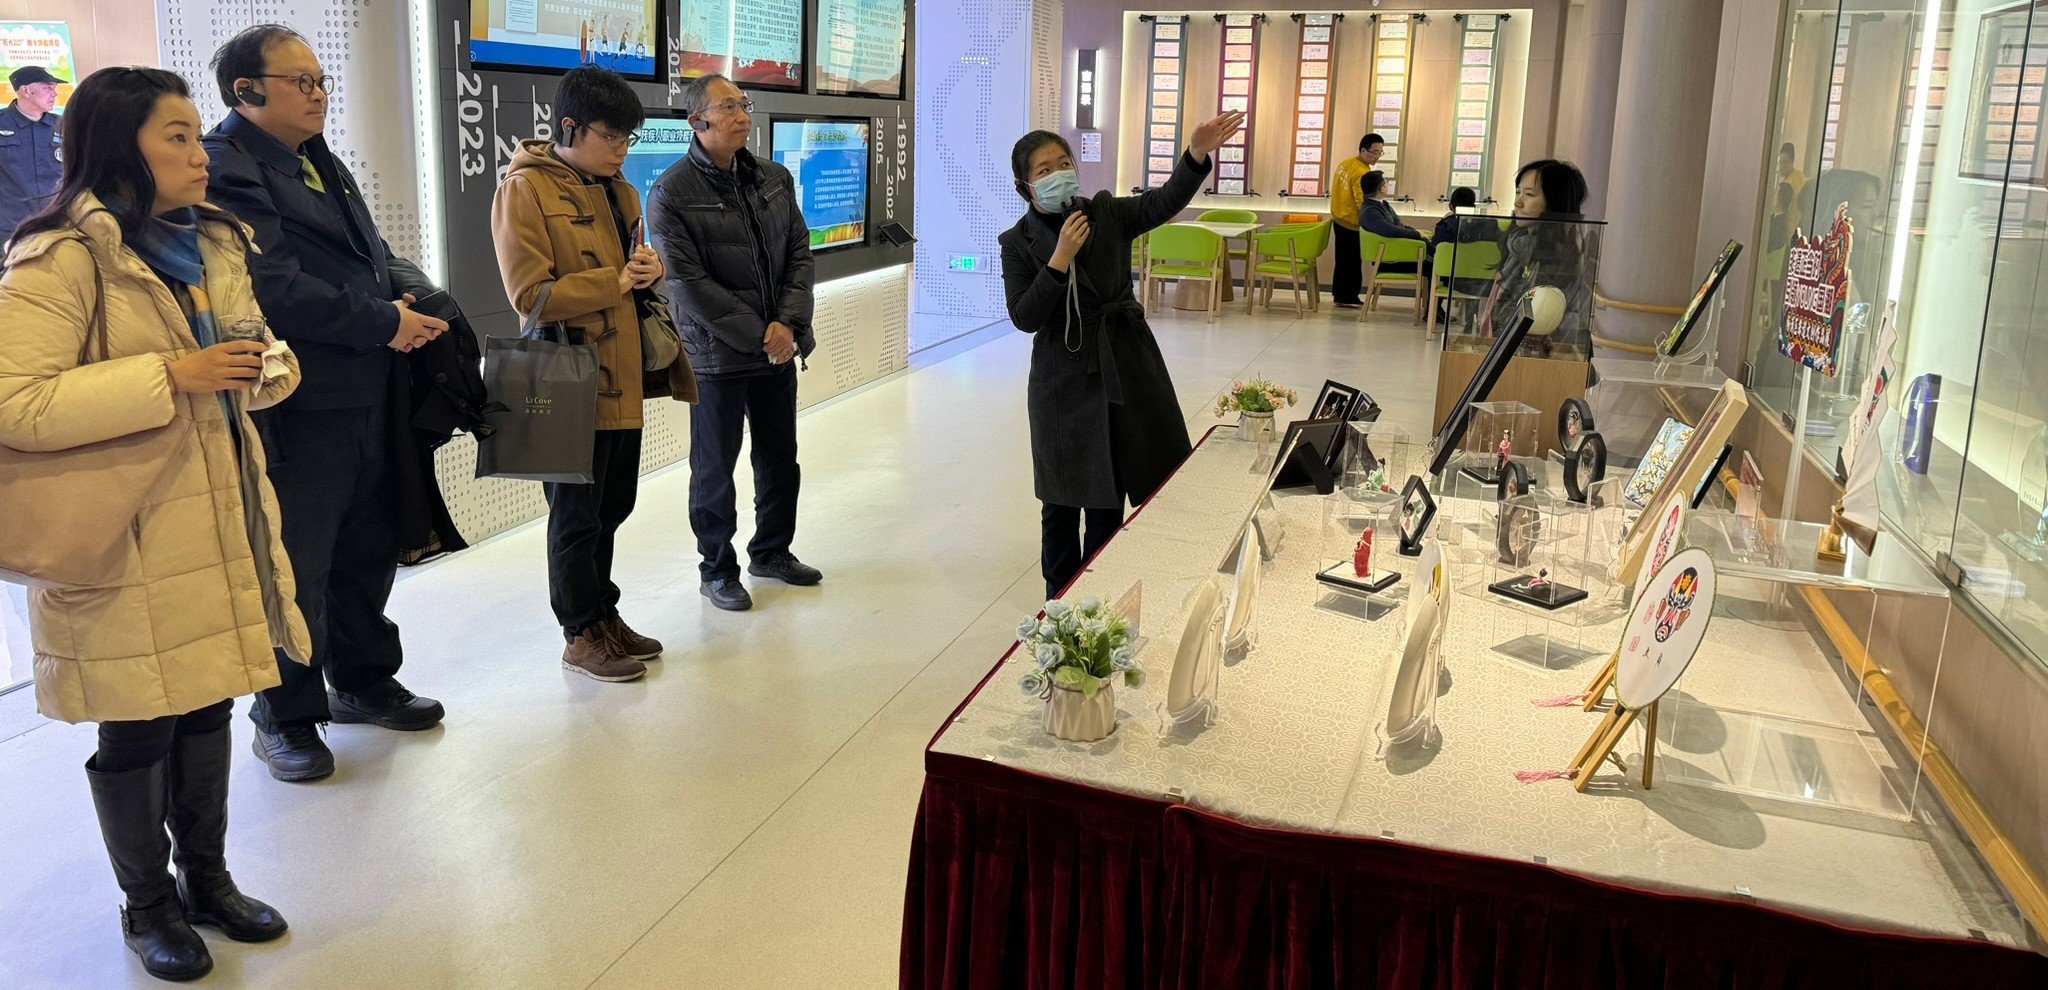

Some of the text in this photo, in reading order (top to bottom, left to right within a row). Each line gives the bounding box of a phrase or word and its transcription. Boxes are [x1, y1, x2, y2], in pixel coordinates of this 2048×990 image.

[668, 37, 682, 96] 2014
[457, 71, 486, 177] 2023
[876, 117, 884, 165] 2005
[897, 119, 907, 182] 1992
[886, 174, 894, 220] 2002
